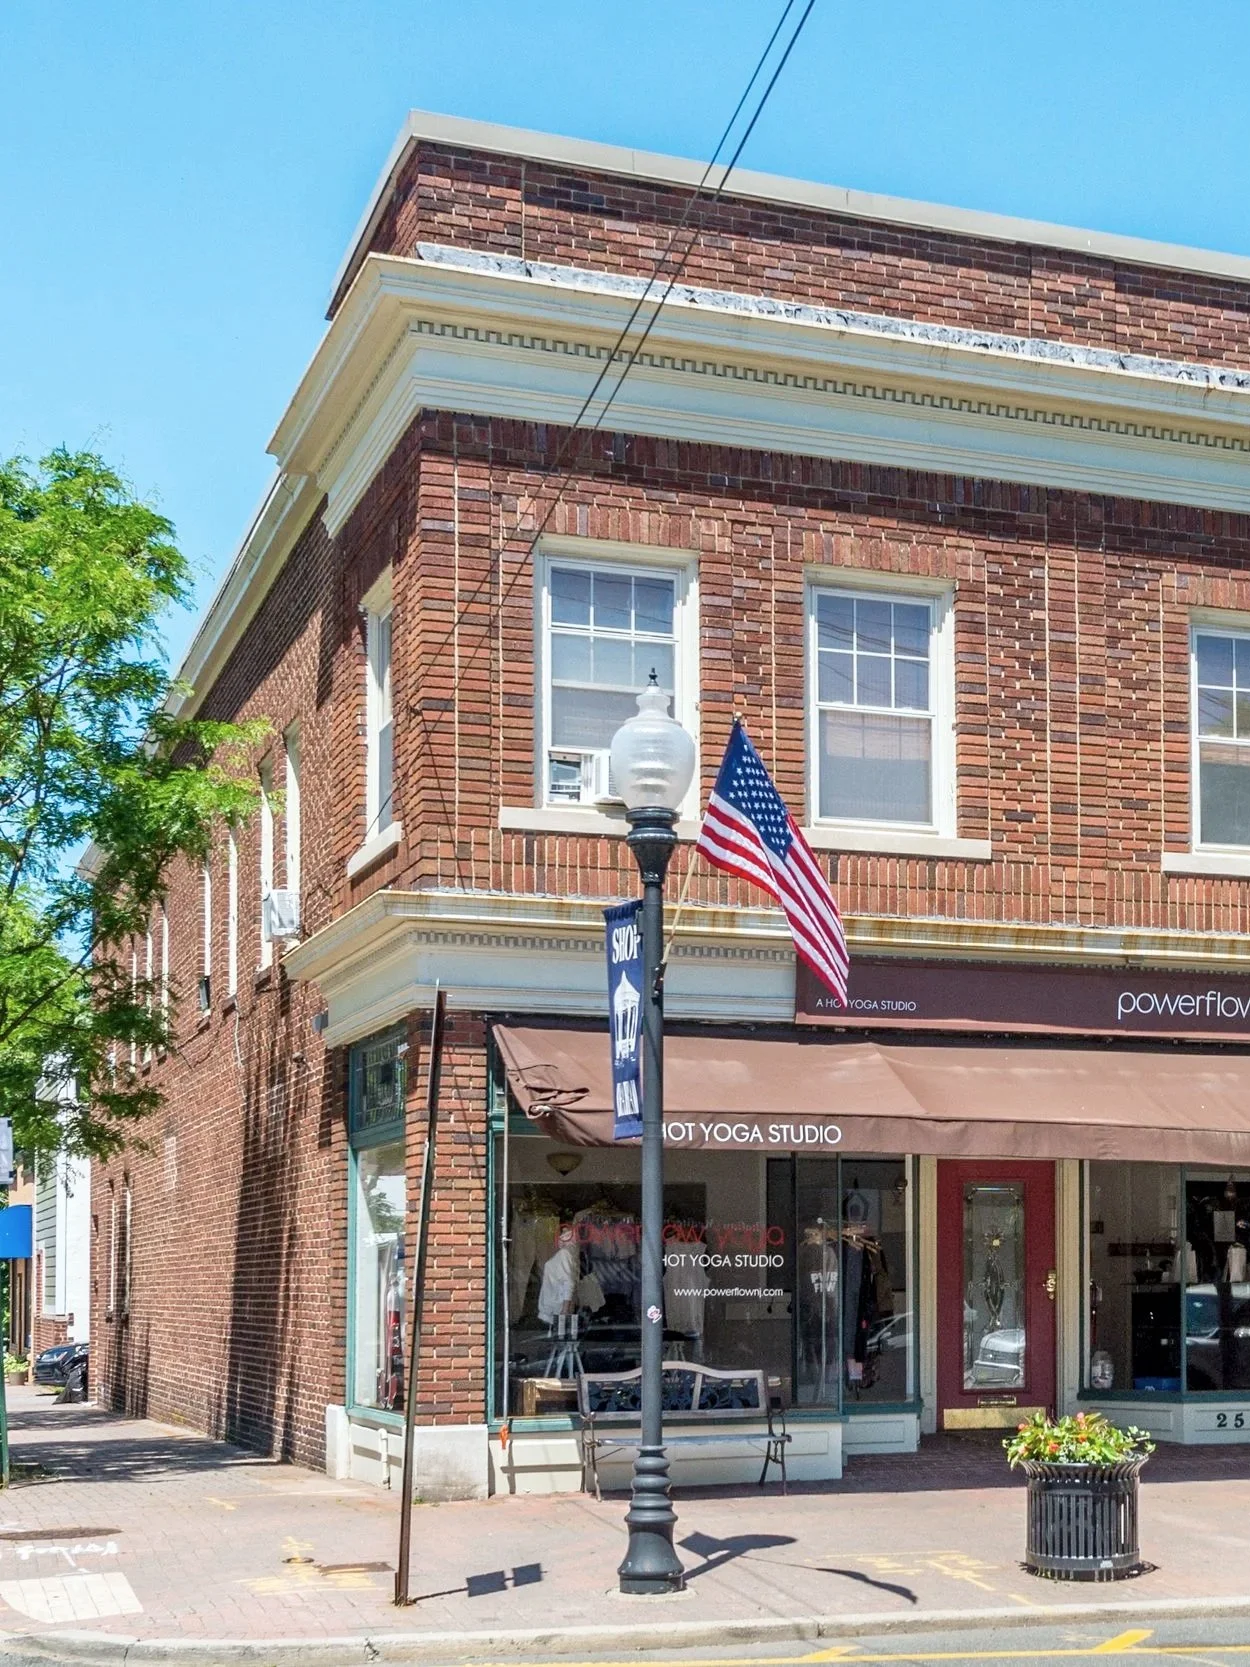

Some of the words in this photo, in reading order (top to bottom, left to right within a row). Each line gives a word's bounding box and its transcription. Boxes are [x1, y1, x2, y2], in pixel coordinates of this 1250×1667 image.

[816, 998, 824, 1008] A
[825, 999, 844, 1009] HO
[848, 999, 879, 1010] YOGA
[880, 1000, 917, 1011] STUDIO
[699, 1123, 764, 1143] YOGA
[768, 1124, 842, 1144] STUDIO
[690, 1254, 732, 1268] YOGA
[734, 1254, 784, 1268] STUDIO
[673, 1287, 784, 1299] www.powerflownj.com
